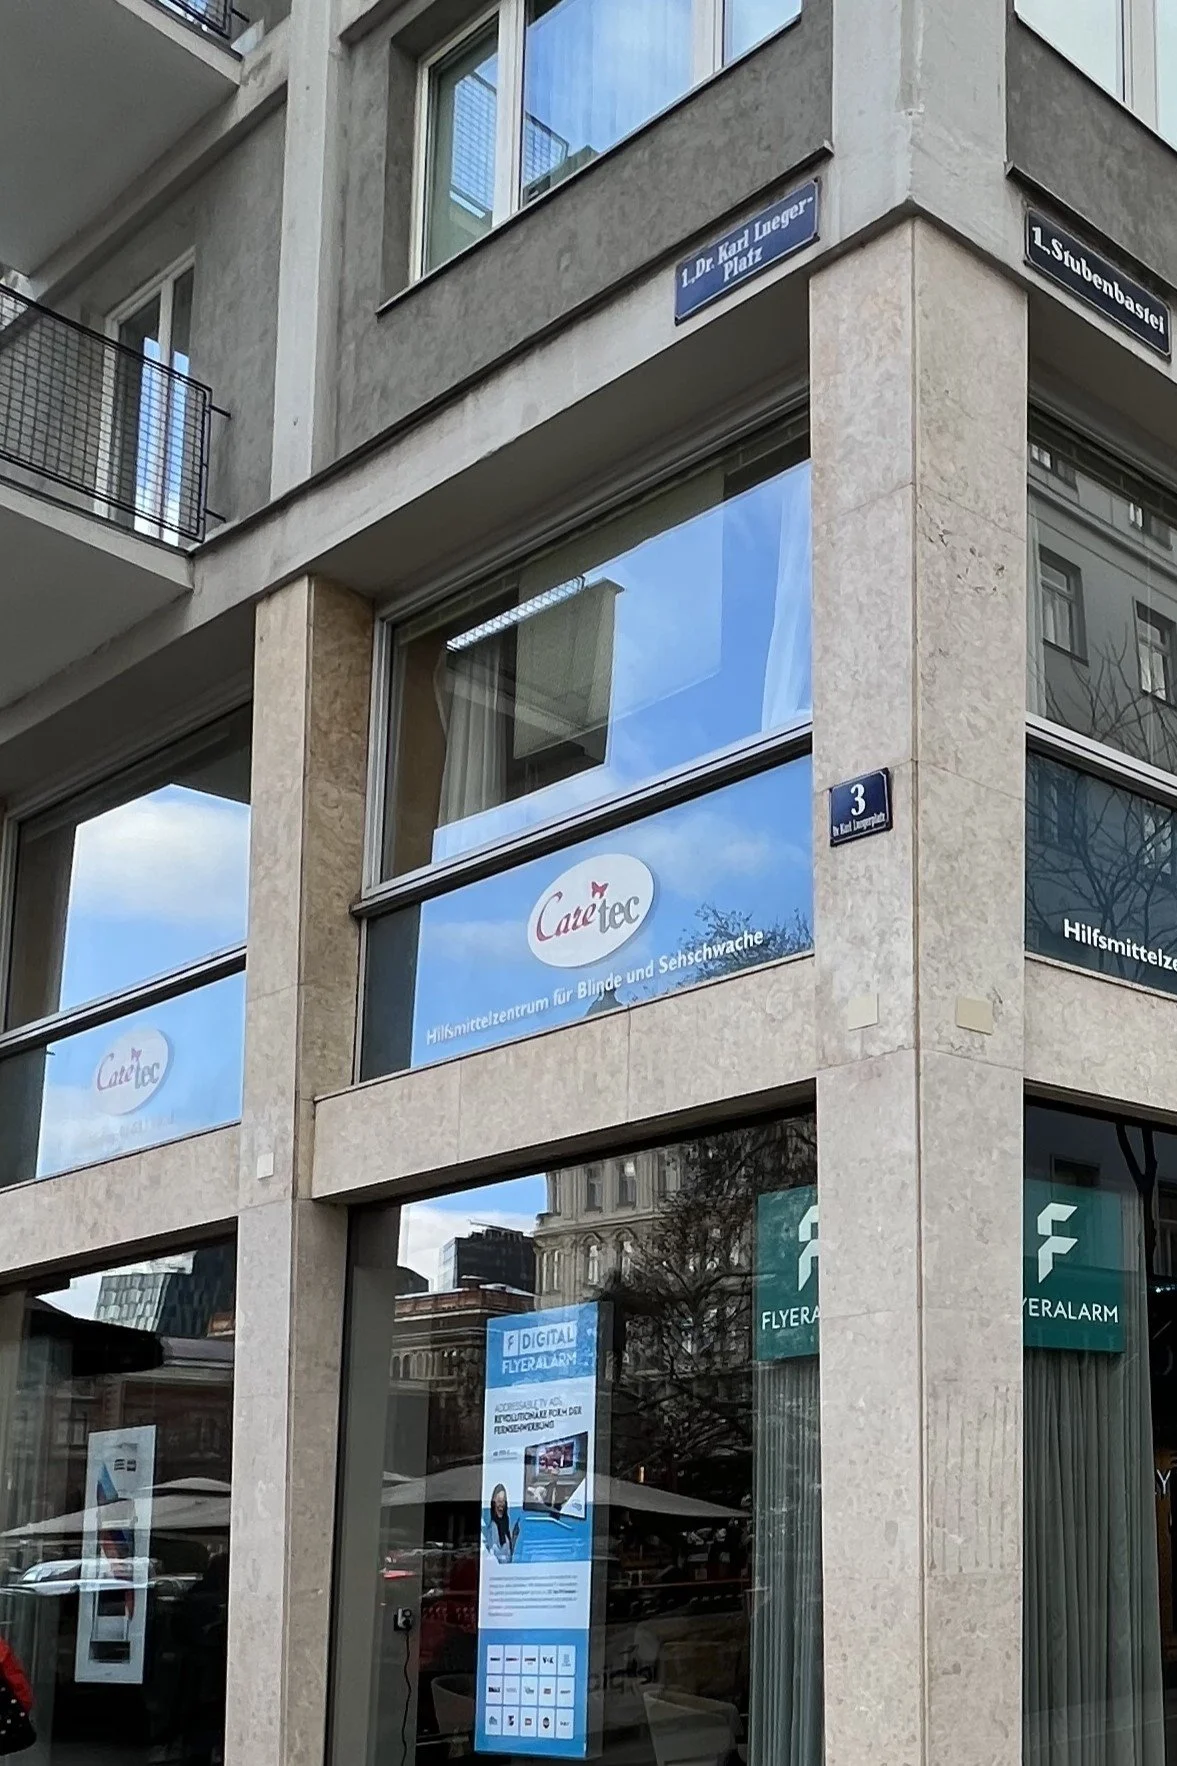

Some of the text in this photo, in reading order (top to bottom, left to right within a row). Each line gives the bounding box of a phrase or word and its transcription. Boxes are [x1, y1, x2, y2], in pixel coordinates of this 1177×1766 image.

[695, 257, 714, 280] Dr.
[718, 229, 749, 265] Karl
[754, 196, 813, 242] Lueger-
[724, 246, 762, 282] Platz
[1051, 238, 1165, 334] Stubenbastei
[850, 783, 866, 816] 3
[427, 929, 764, 1045] Hilfsmittelzentrum für Blinde und Sehschwache
[521, 1326, 575, 1349] DIGITAL
[502, 1351, 576, 1375] FLYERALARM
